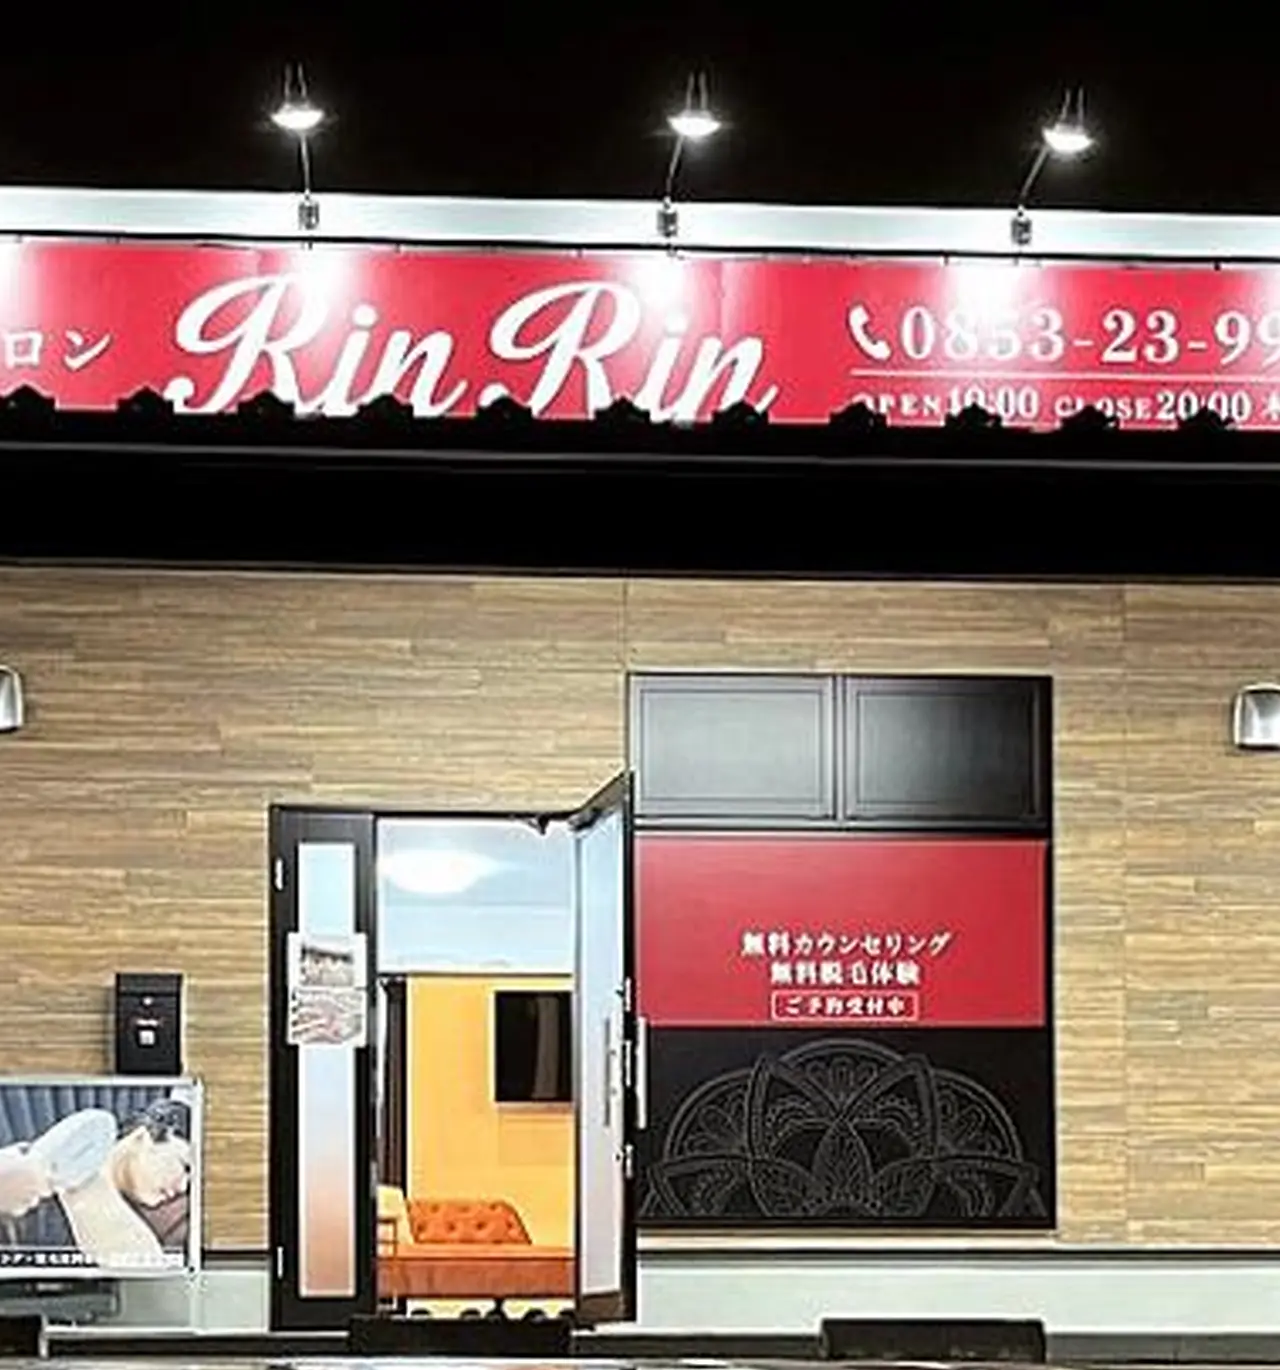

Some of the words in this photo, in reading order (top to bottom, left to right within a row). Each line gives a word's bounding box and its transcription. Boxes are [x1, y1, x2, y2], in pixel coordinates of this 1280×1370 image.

[164, 273, 468, 417] Rin
[478, 279, 779, 422] Rin
[741, 931, 952, 956] 無料カウンセリング
